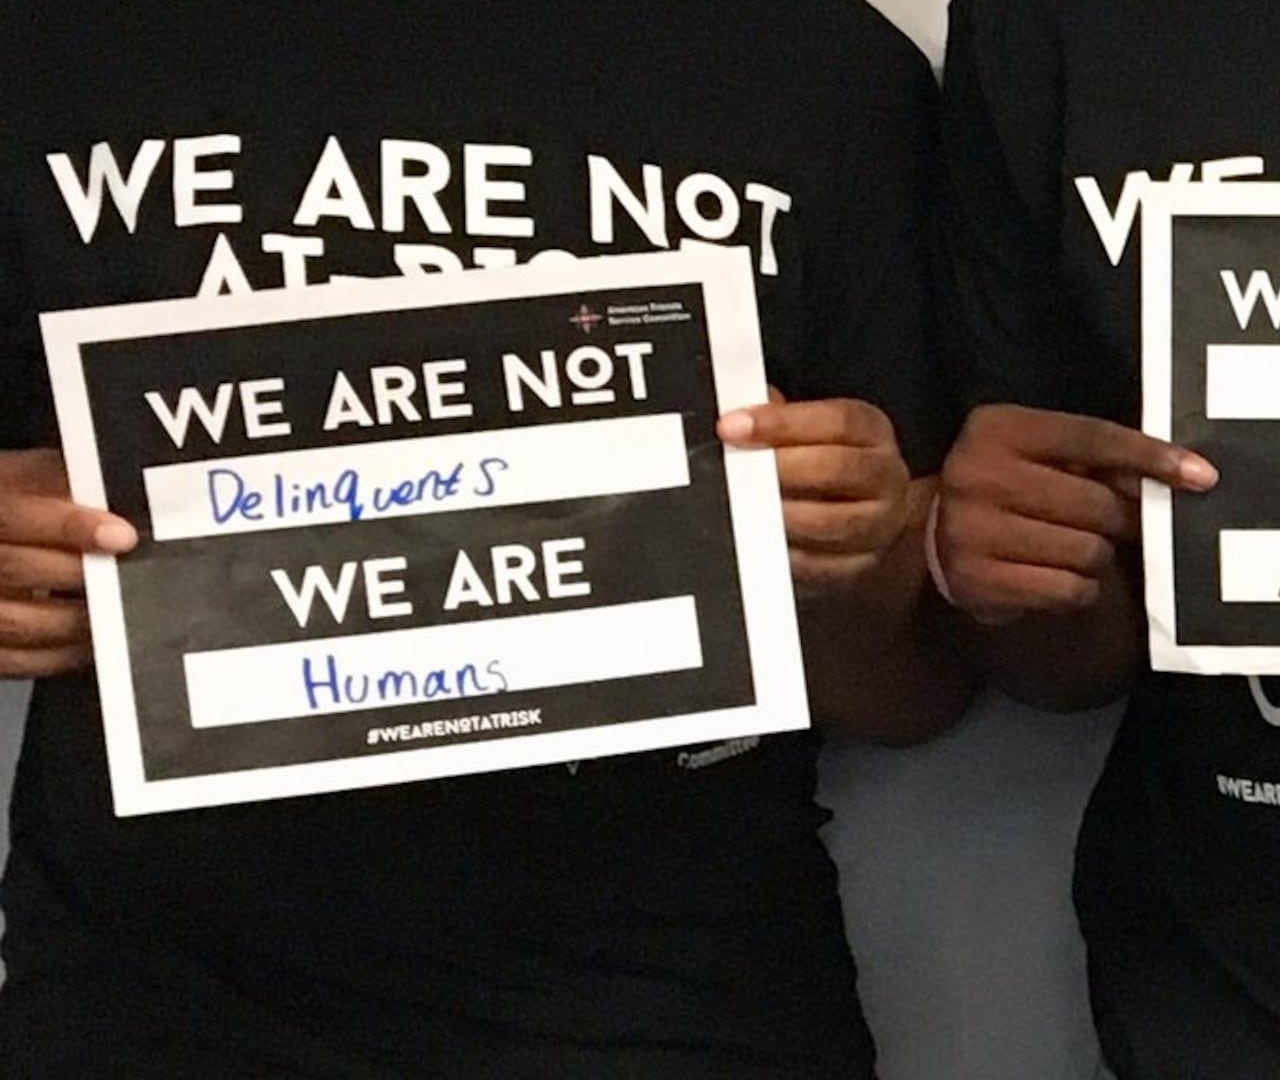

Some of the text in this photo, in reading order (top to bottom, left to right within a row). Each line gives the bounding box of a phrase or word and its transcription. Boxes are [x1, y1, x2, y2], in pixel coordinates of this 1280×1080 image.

[47, 135, 242, 243] WE
[294, 136, 534, 237] ARE
[588, 155, 791, 275] NOT
[145, 343, 652, 447] WE ARE NOT
[271, 538, 590, 627] WE ARE
[303, 654, 509, 710] Humans
[368, 709, 541, 744] #WEARENOTATRISK
